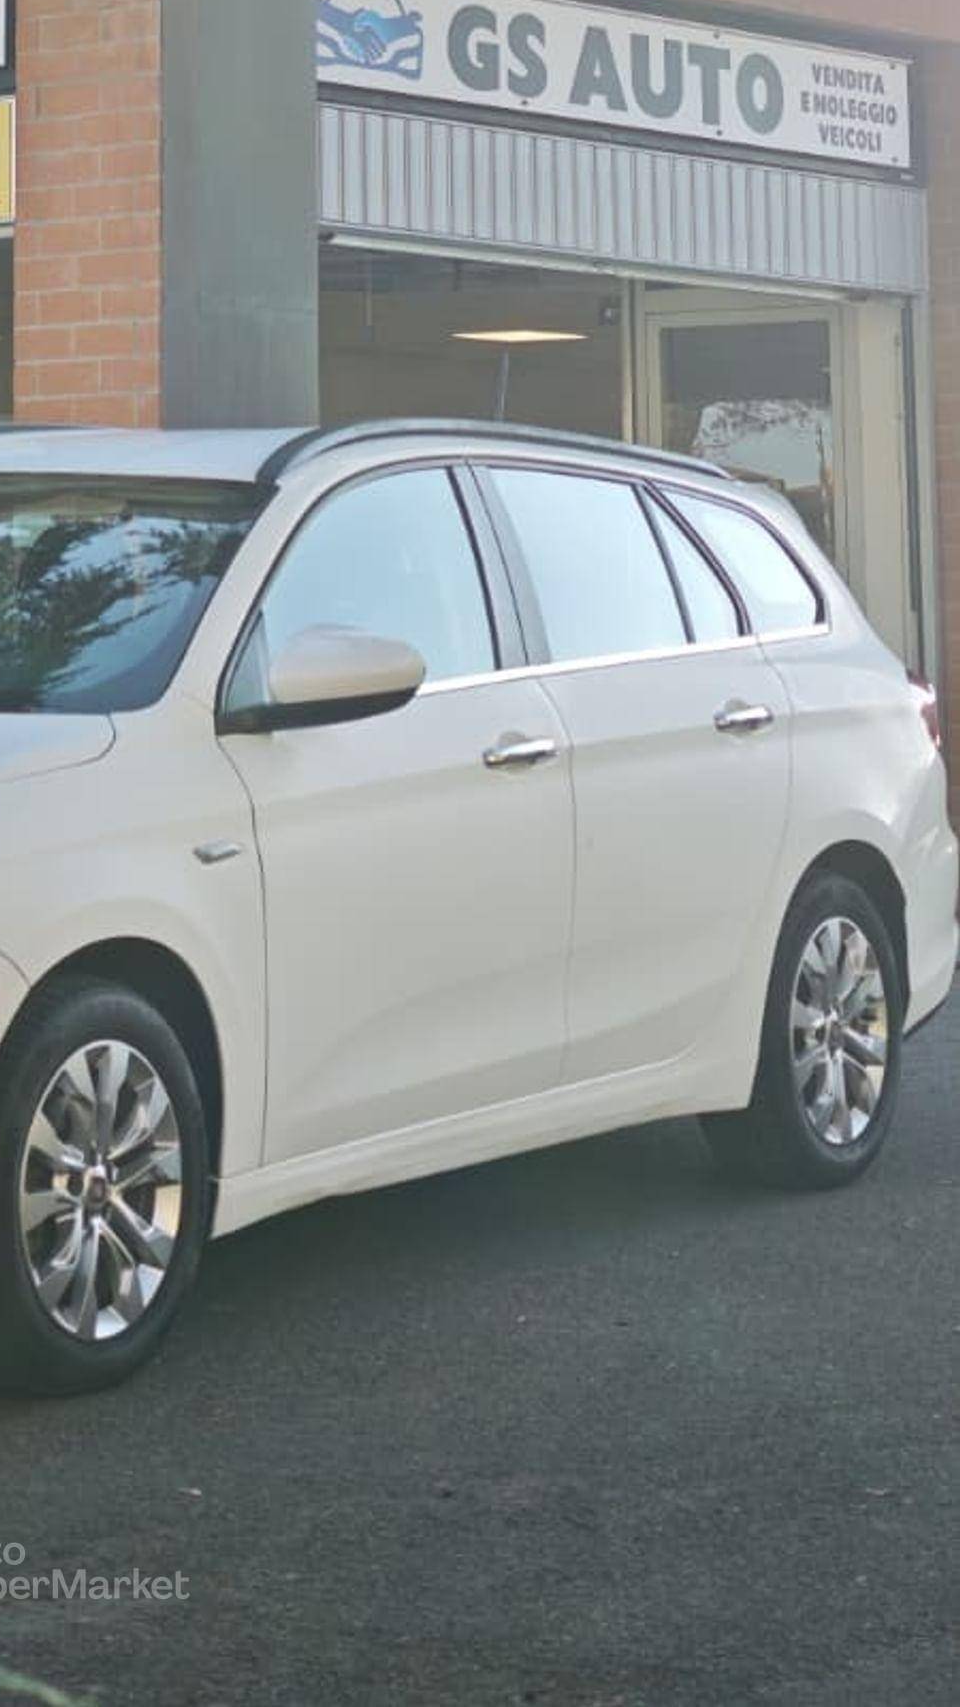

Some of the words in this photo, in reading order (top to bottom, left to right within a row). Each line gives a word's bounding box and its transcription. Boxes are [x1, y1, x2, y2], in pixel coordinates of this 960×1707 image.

[446, 4, 548, 99] GS
[568, 26, 785, 135] AUTO
[811, 62, 885, 95] VENDITA
[801, 91, 811, 113] E
[813, 93, 897, 125] NOLEGGIO
[818, 122, 882, 153] VEICOLI
